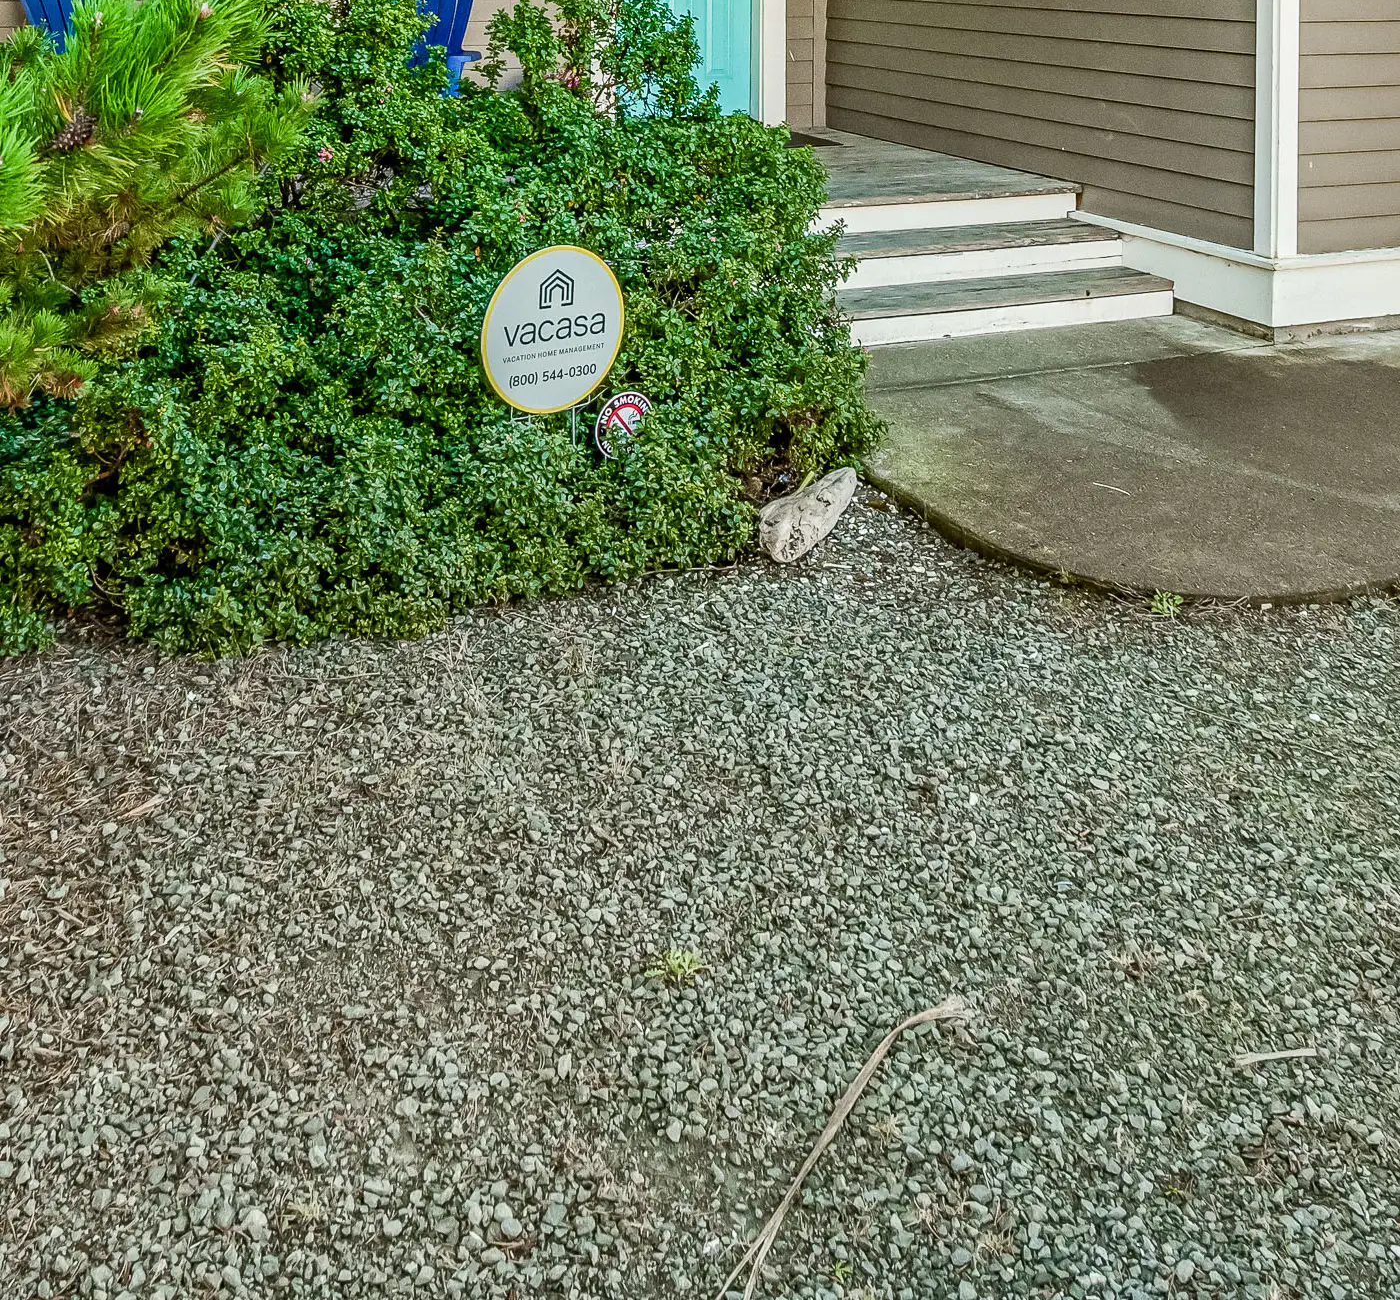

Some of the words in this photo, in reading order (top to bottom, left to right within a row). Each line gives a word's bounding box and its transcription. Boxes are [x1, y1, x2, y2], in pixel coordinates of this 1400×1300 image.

[503, 312, 606, 347] vacasa
[502, 353, 536, 364] VACATION
[537, 349, 558, 358] HOME
[558, 342, 605, 355] MANAGEMENT
[509, 372, 538, 389] (800)
[542, 363, 597, 382] 544-0300
[600, 407, 613, 425] NO
[613, 395, 649, 414] SMOKIN
